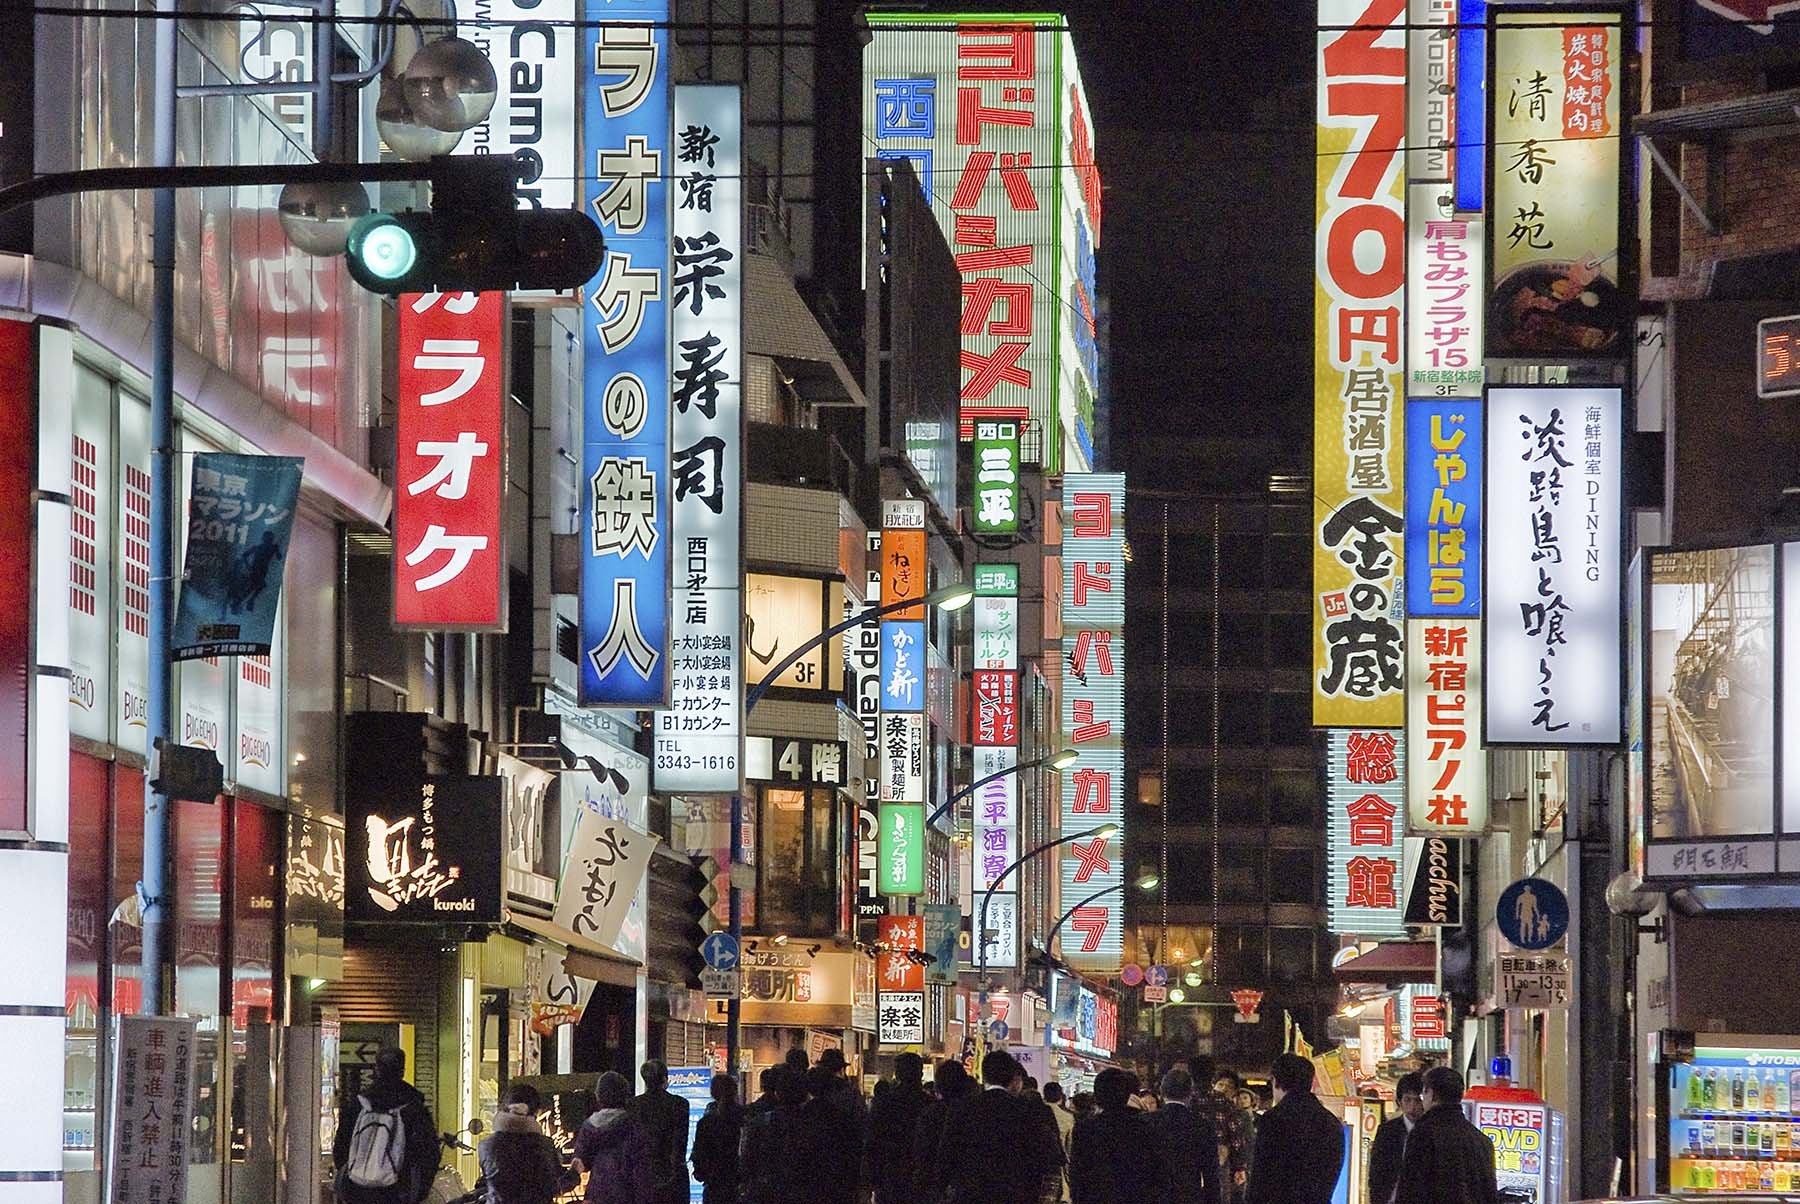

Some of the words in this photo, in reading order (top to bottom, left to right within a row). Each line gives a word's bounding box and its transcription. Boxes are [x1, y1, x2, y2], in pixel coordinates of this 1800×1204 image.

[511, 22, 556, 209] Camer
[679, 125, 721, 213] 新宿
[1505, 70, 1556, 251] 清香苑
[1424, 220, 1470, 368] 肩もみプラザ15
[587, 0, 661, 681] ラオケの鉄人
[673, 230, 733, 514] 栄寿司
[1413, 370, 1481, 383] 新宿整体院
[1435, 384, 1459, 397] 3F
[977, 423, 1016, 440] 西口
[1345, 369, 1391, 490] 居酒屋
[1585, 406, 1602, 475] 海鮮個室
[194, 497, 291, 526] マラソン
[977, 447, 1016, 526] 三平
[1427, 414, 1467, 606] じゃんぱら
[191, 520, 250, 546] 2011
[1586, 480, 1601, 582] DINING
[890, 551, 911, 598] ねぎし
[795, 662, 816, 684] 3F
[886, 628, 919, 705] かど新
[682, 696, 730, 711] カウンター
[682, 716, 730, 731] カウンター
[1070, 493, 1113, 952] ヨドバシカメラ
[1425, 626, 1471, 825] 新宿ピアノ社
[657, 756, 735, 769] 3343-1616
[658, 740, 681, 752] TEL
[1346, 733, 1398, 908] 総合館
[433, 898, 475, 911] kuroki
[881, 1006, 921, 1028] 楽釜
[1762, 1056, 1784, 1065] ITO
[1482, 1127, 1540, 1151] DVD
